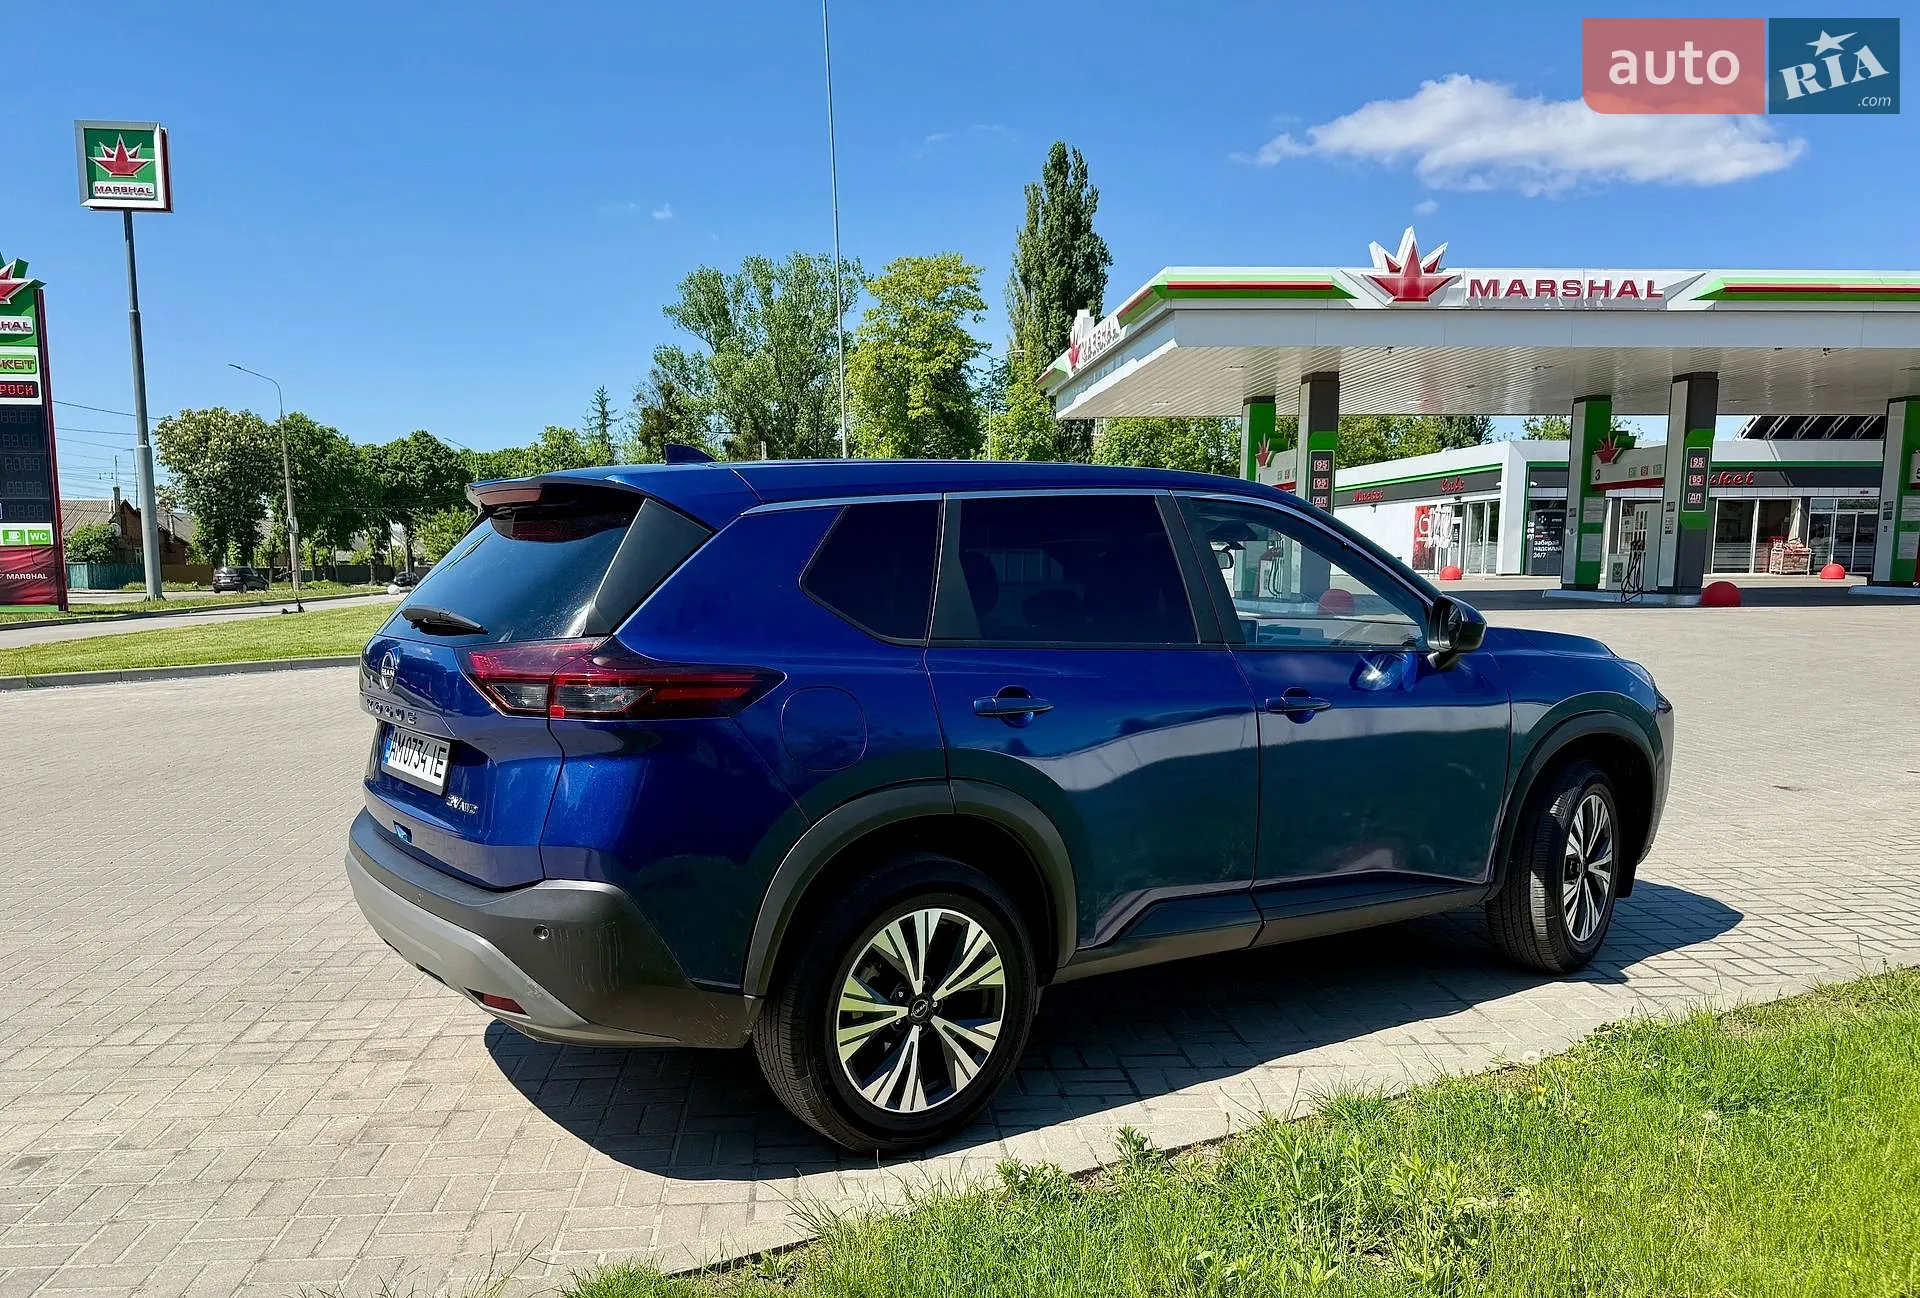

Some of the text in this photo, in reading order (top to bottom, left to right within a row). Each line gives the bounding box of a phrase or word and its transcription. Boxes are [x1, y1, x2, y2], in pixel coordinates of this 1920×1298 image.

[94, 186, 153, 195] MARSHAL
[1469, 279, 1665, 298] MARSHAL
[1595, 469, 1601, 481] 3
[29, 532, 47, 541] WC
